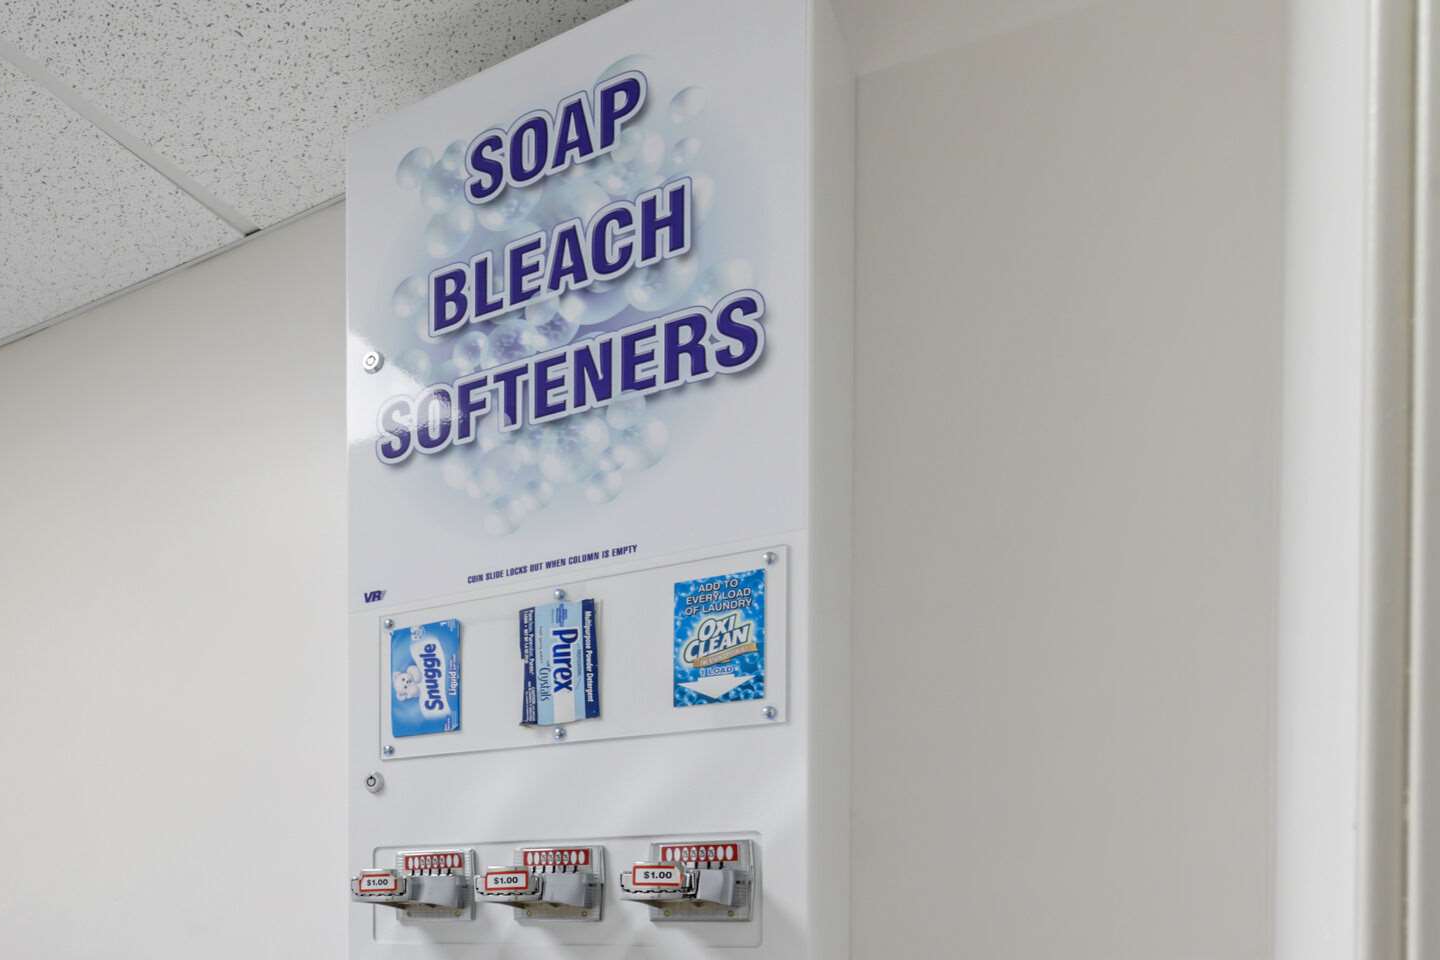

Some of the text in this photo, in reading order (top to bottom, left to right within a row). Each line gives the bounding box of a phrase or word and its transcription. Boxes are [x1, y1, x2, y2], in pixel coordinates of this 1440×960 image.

[468, 75, 644, 201] SOAP
[431, 182, 688, 334] BLEACH
[379, 294, 761, 461] SOFTENERS
[467, 544, 638, 584] COIN SLIDE LOCKS OUT WHEN COLUMN IS EMPTY
[686, 587, 751, 605] EVERY LOAD
[698, 579, 739, 593] ADD TO
[685, 598, 752, 615] OF LAUNDRY
[684, 623, 751, 663] CLEAN
[698, 613, 737, 641] OXI
[552, 628, 578, 693] Purex
[583, 611, 595, 702] Multipurpose Powder Detergent
[419, 643, 444, 711] Snuggle
[448, 671, 458, 696] Liquid
[538, 667, 551, 701] Crystals
[366, 878, 389, 887] $1.00
[493, 876, 519, 886] $1.00
[643, 871, 673, 880] $1.00
